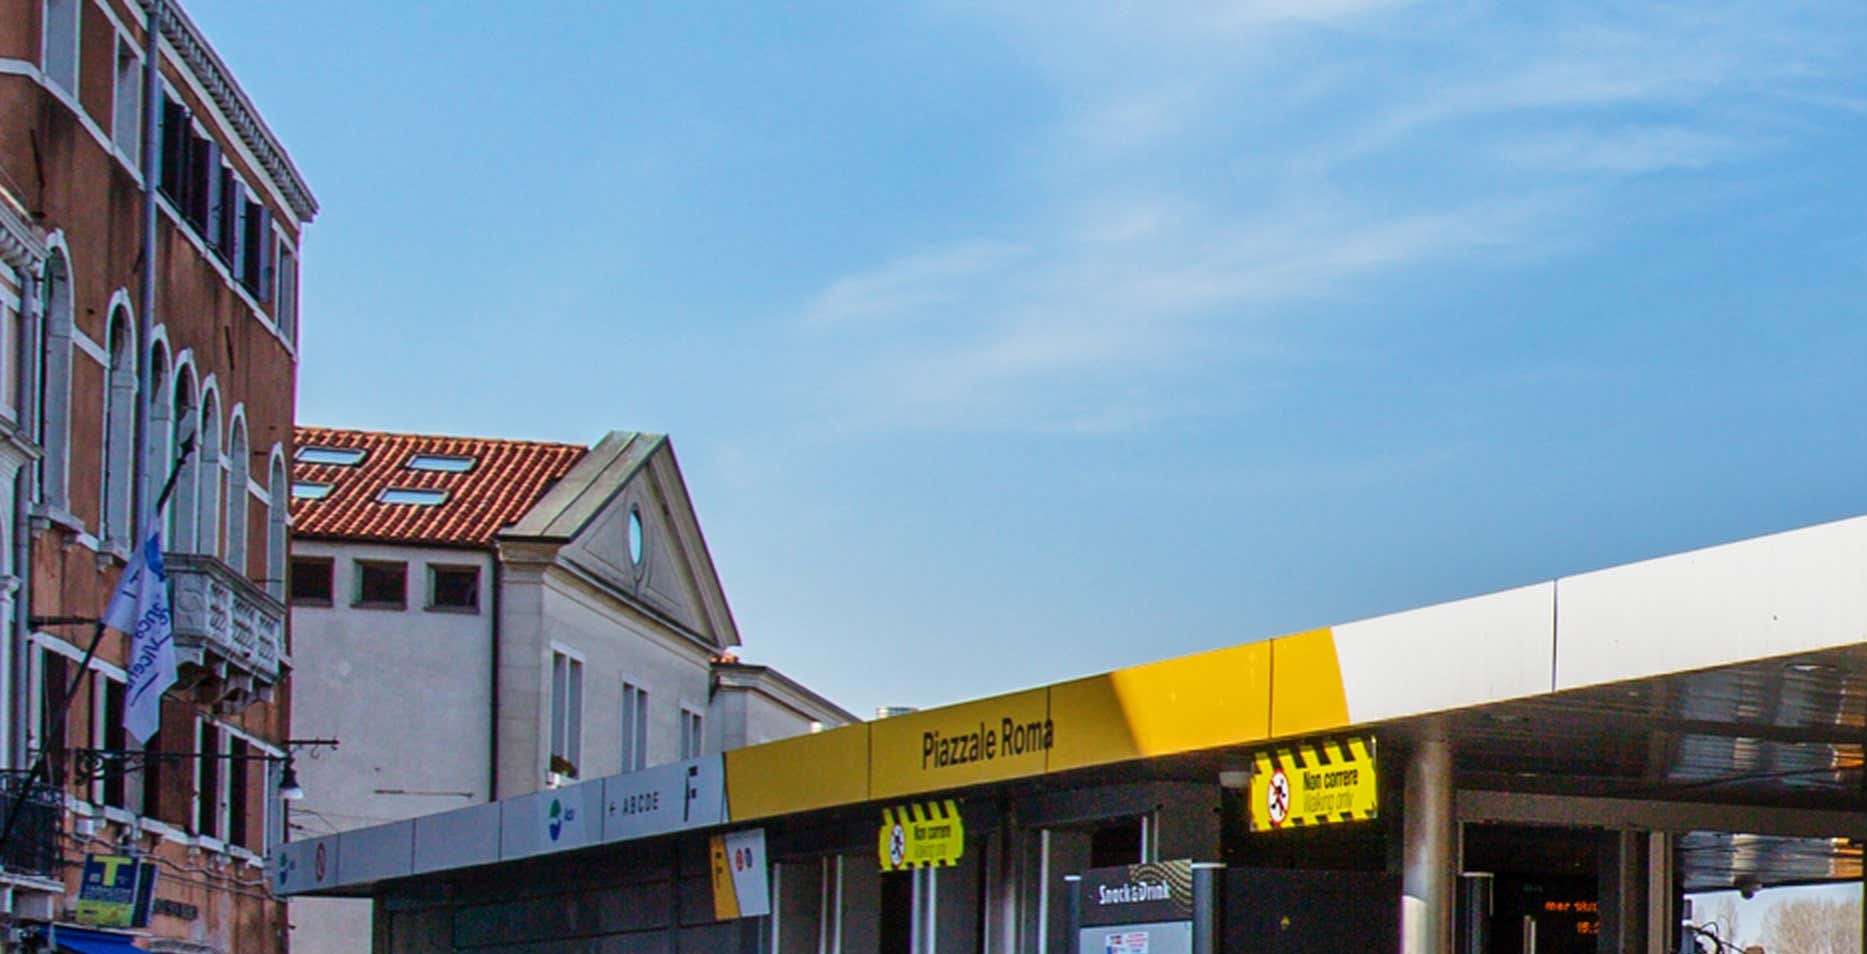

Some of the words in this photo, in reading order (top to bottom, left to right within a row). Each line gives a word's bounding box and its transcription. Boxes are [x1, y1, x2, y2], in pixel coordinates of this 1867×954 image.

[922, 721, 997, 770] Piazzale
[1001, 716, 1055, 757] Roma
[1303, 771, 1322, 791] Non
[1324, 768, 1359, 789] correre
